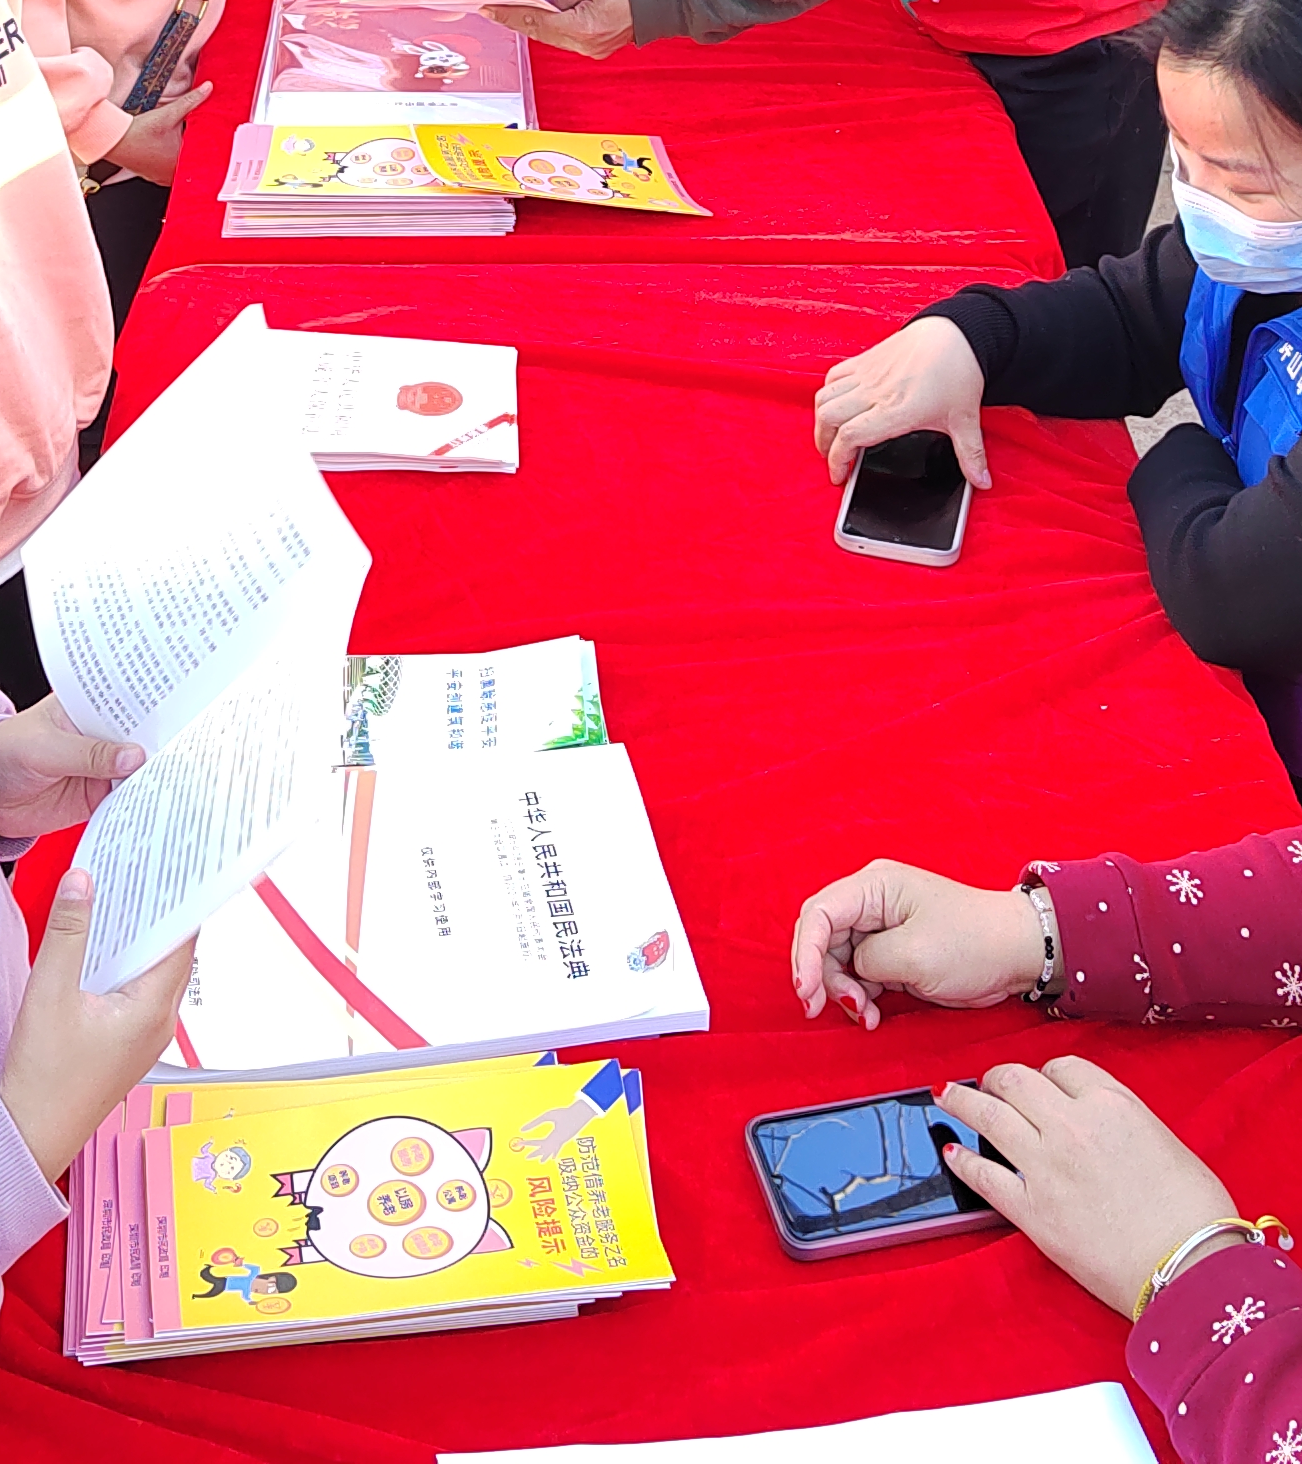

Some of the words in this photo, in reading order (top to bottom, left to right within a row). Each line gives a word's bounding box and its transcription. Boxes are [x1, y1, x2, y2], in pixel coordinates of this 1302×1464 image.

[421, 846, 452, 938] 仅供内部学习使用
[518, 791, 591, 980] 中华人民共和国民法典
[525, 1176, 567, 1255] 风险提示
[558, 1157, 599, 1260] 吸纳公众资金的
[576, 1136, 627, 1268] 防范借养老服务之名
